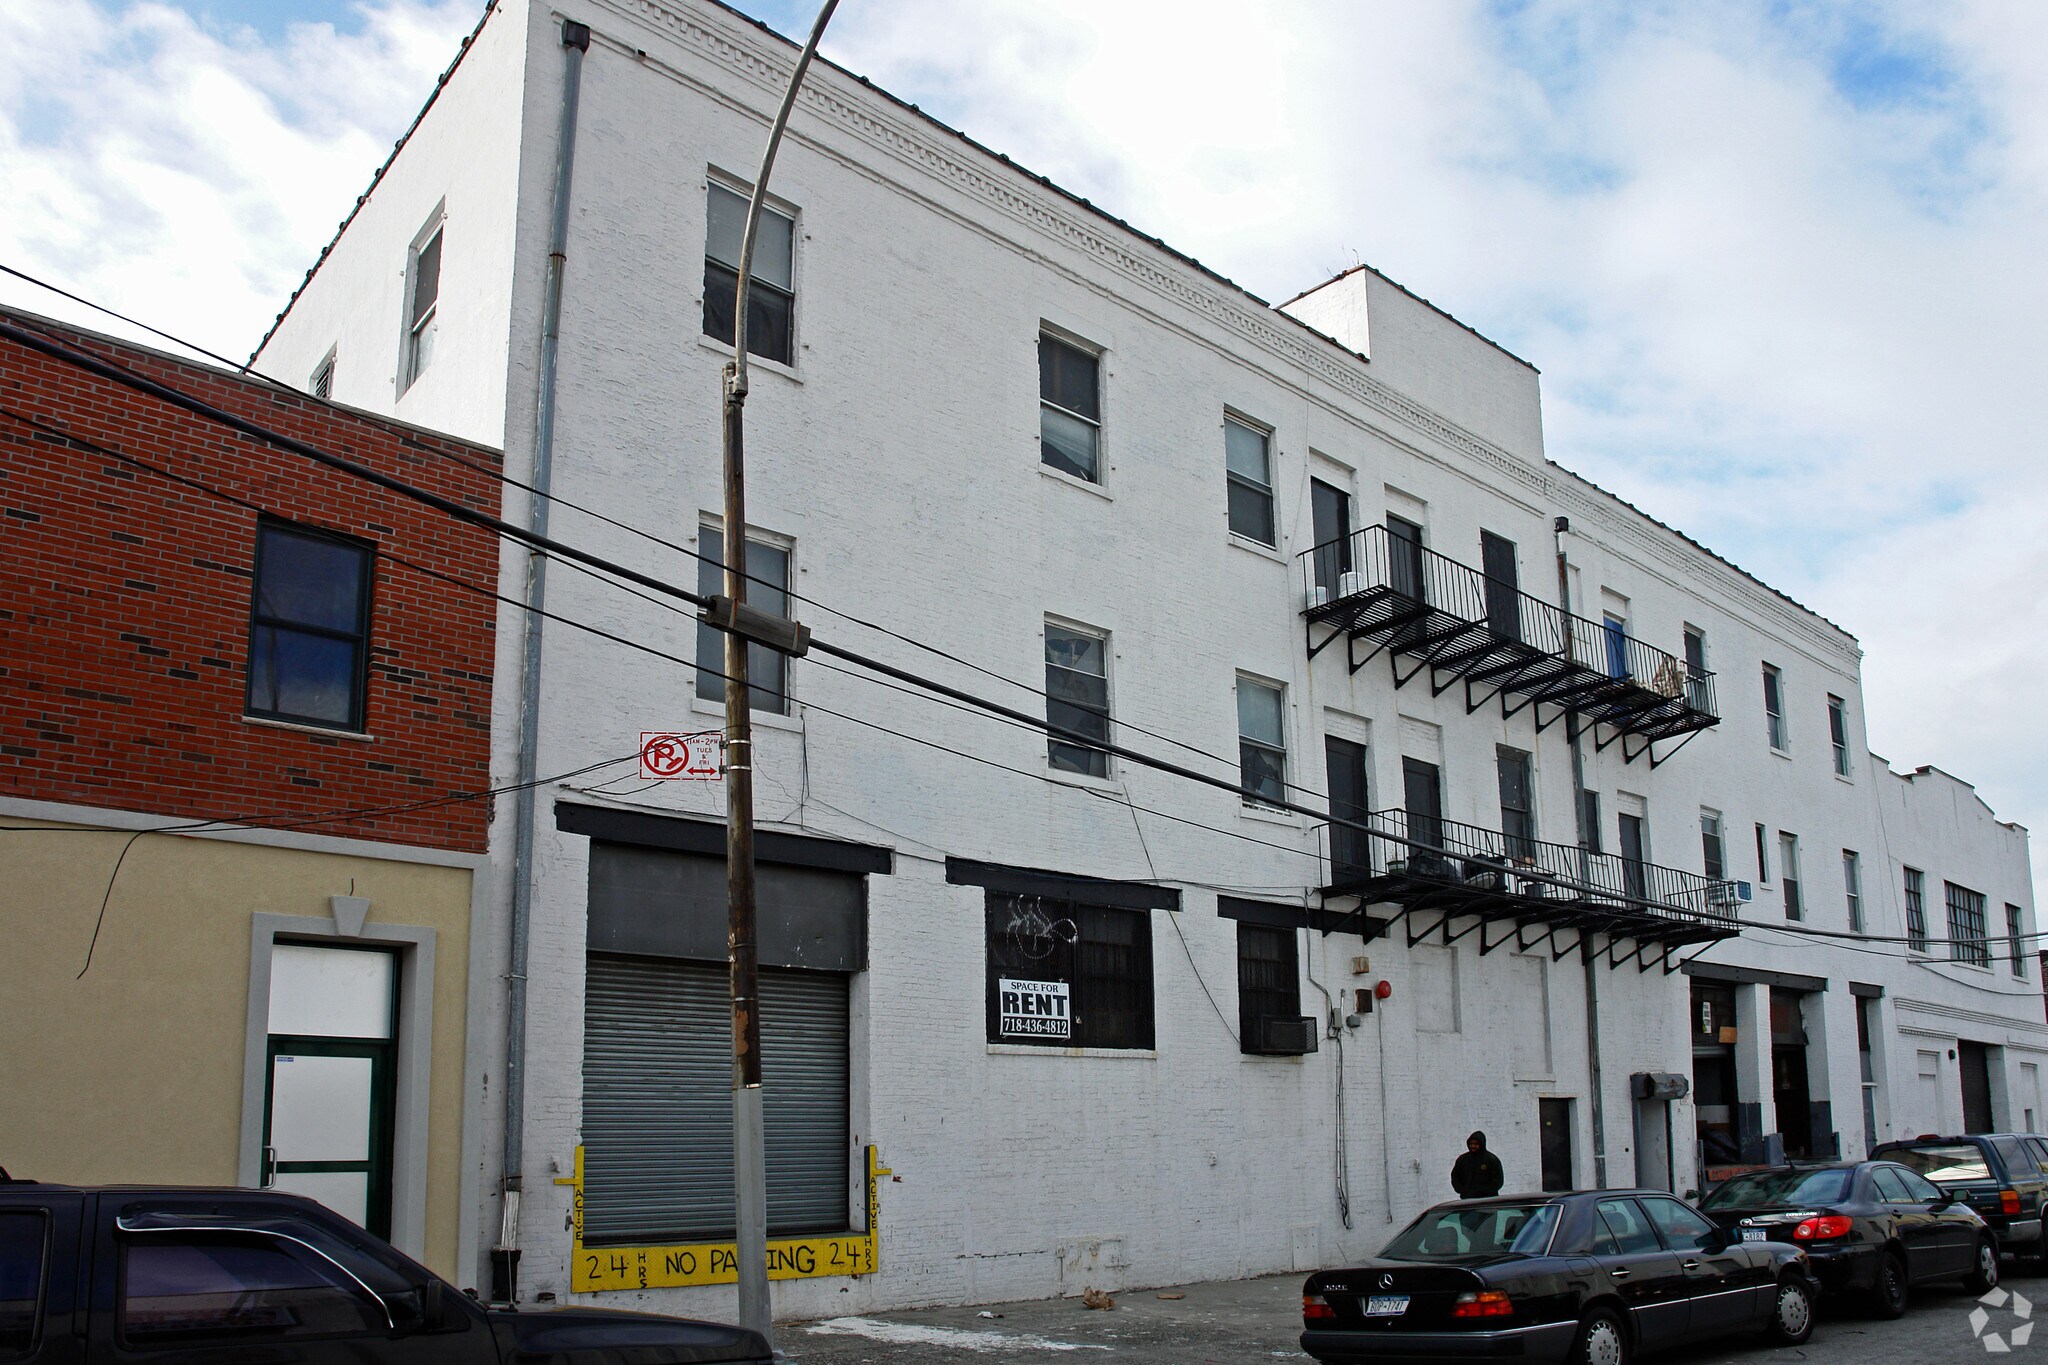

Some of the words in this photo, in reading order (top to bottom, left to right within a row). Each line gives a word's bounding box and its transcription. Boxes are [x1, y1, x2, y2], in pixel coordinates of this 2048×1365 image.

[1002, 991, 1067, 1016] RENT
[1011, 982, 1039, 992] SPACE
[1041, 984, 1059, 993] FOR
[575, 1189, 583, 1241] ACTIVE
[586, 1254, 628, 1279] 24
[638, 1253, 648, 1289] HRS
[666, 1252, 696, 1275] NO
[711, 1245, 816, 1274] PAING
[829, 1242, 861, 1268] 24
[864, 1238, 872, 1270] HRS
